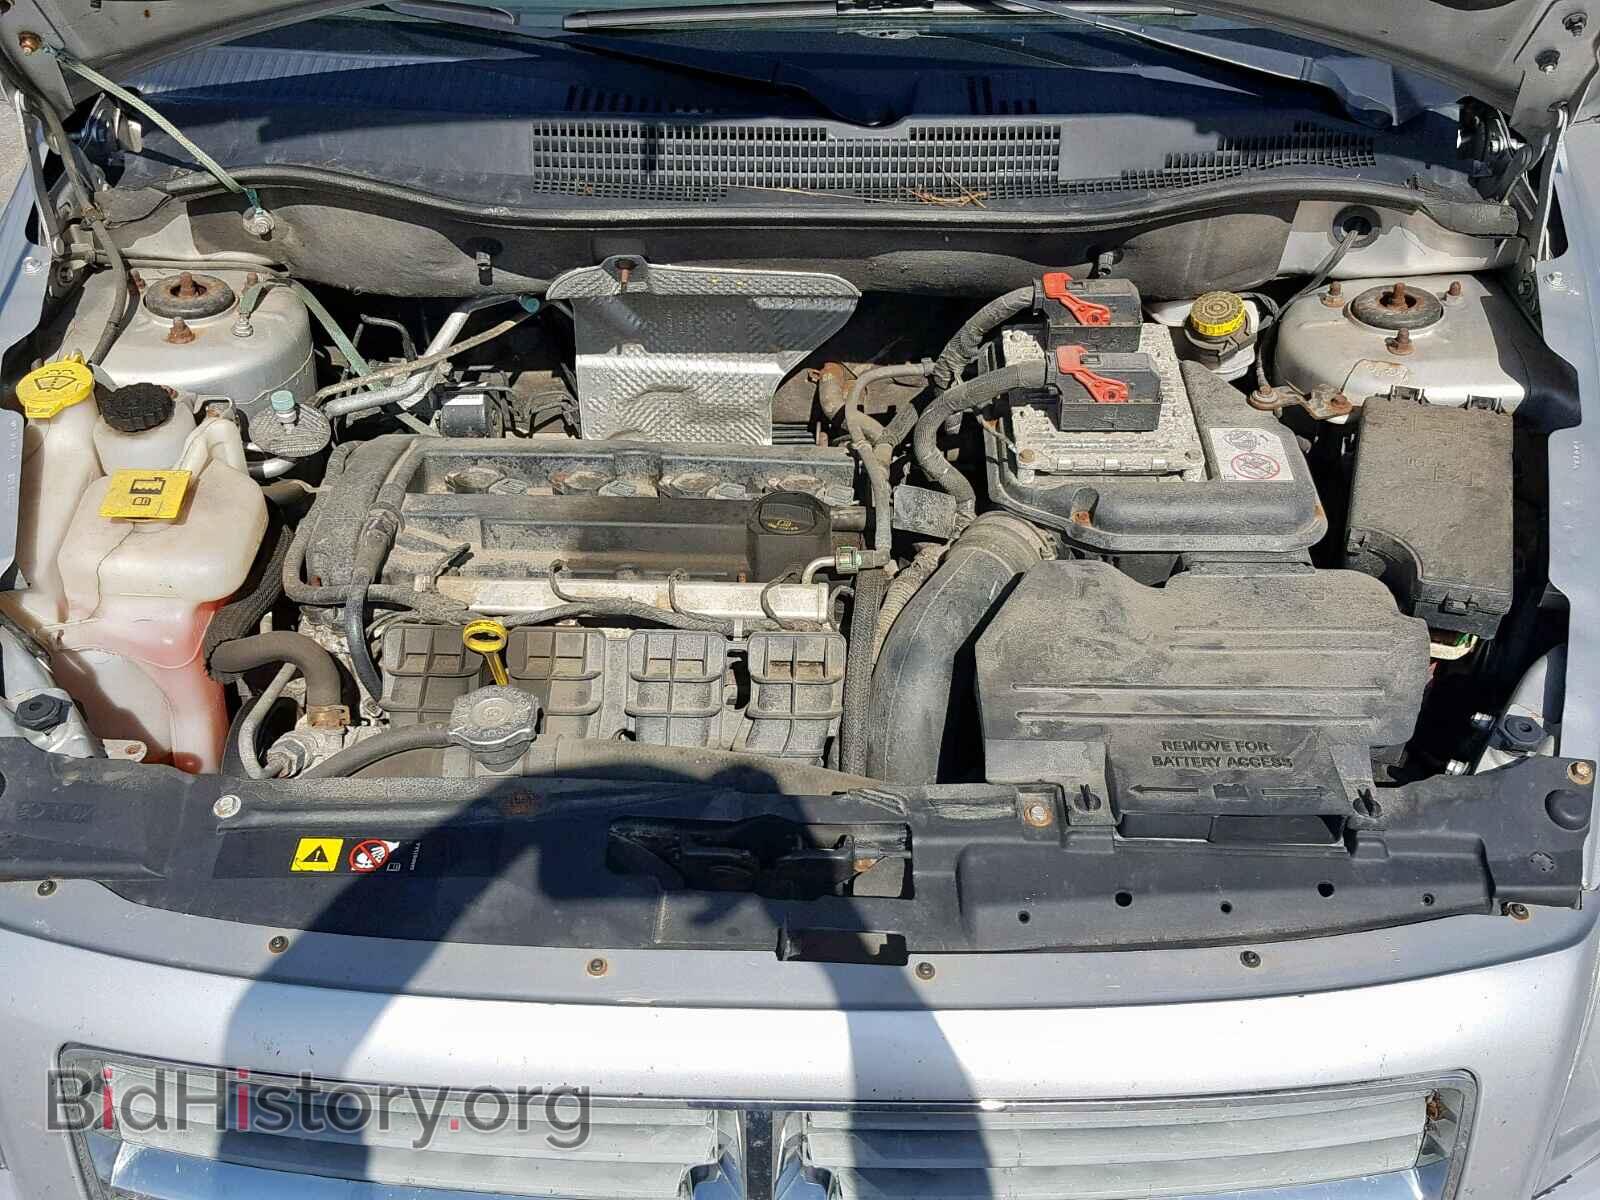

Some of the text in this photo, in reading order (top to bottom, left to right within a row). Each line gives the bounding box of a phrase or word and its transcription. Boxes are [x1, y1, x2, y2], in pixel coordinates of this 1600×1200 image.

[1161, 740, 1272, 753] REMOVE FOR
[1151, 755, 1294, 769] BATTERY ACCESS
